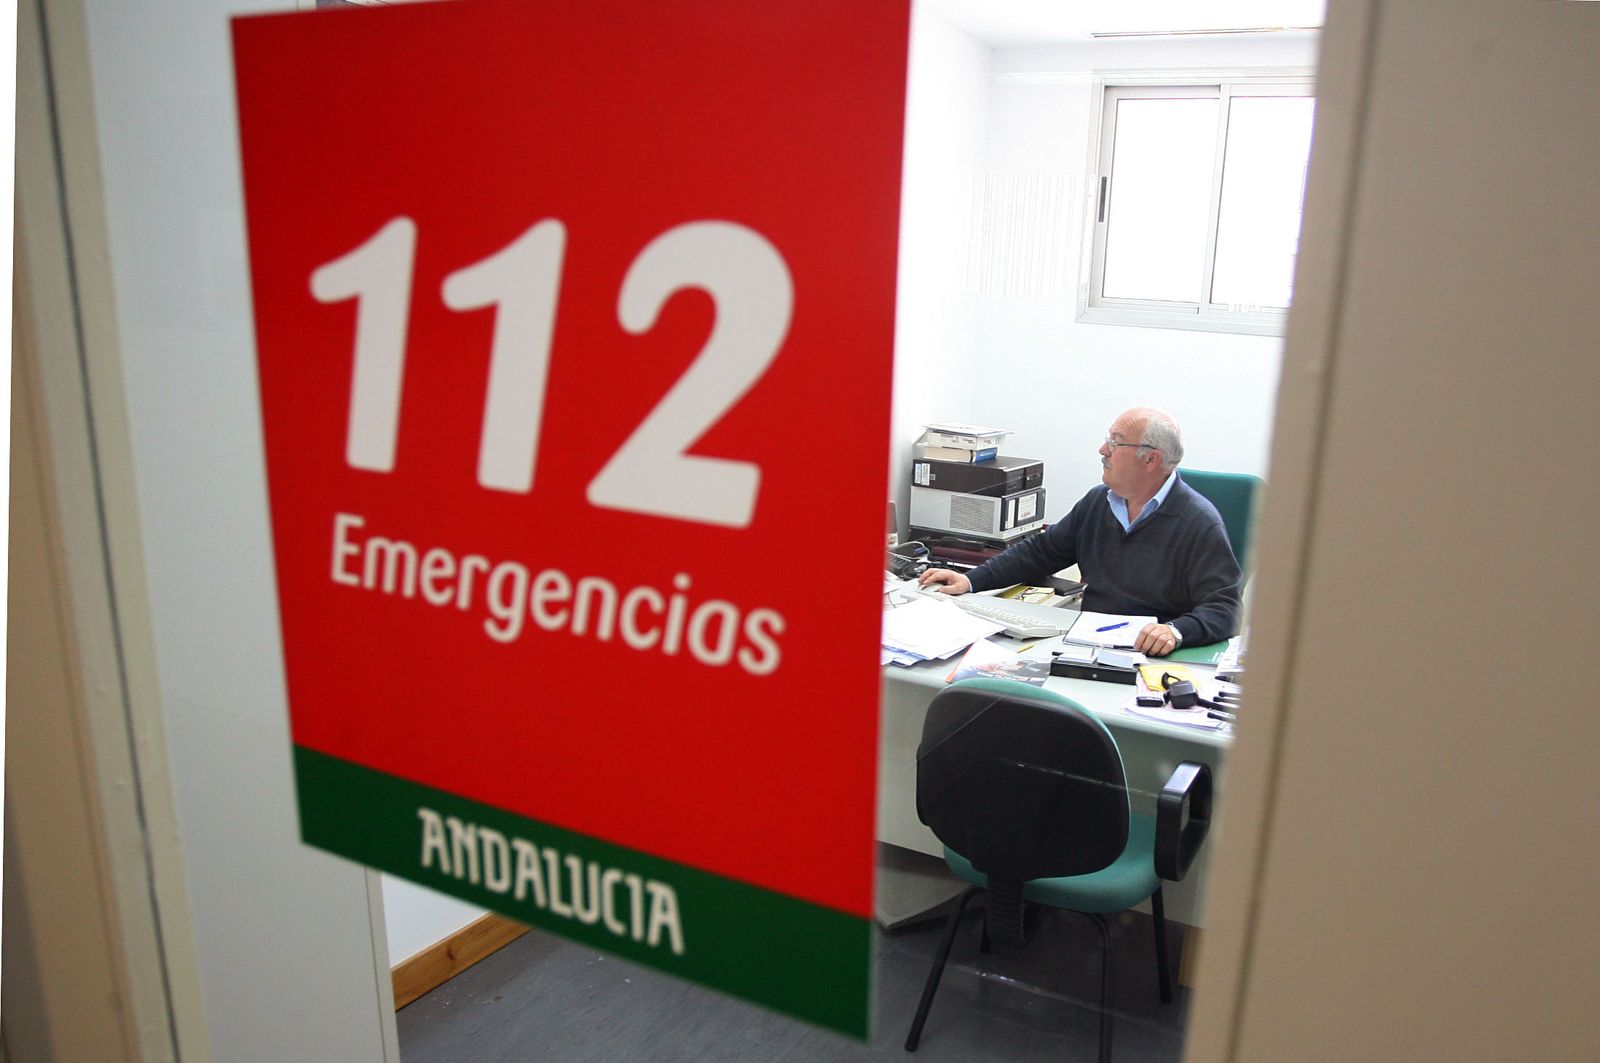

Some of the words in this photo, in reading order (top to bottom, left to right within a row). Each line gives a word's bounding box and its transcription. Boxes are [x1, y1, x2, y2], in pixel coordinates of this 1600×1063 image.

[310, 216, 795, 529] 112
[331, 512, 784, 675] Emergencias
[418, 807, 684, 954] ANDALUCIA
